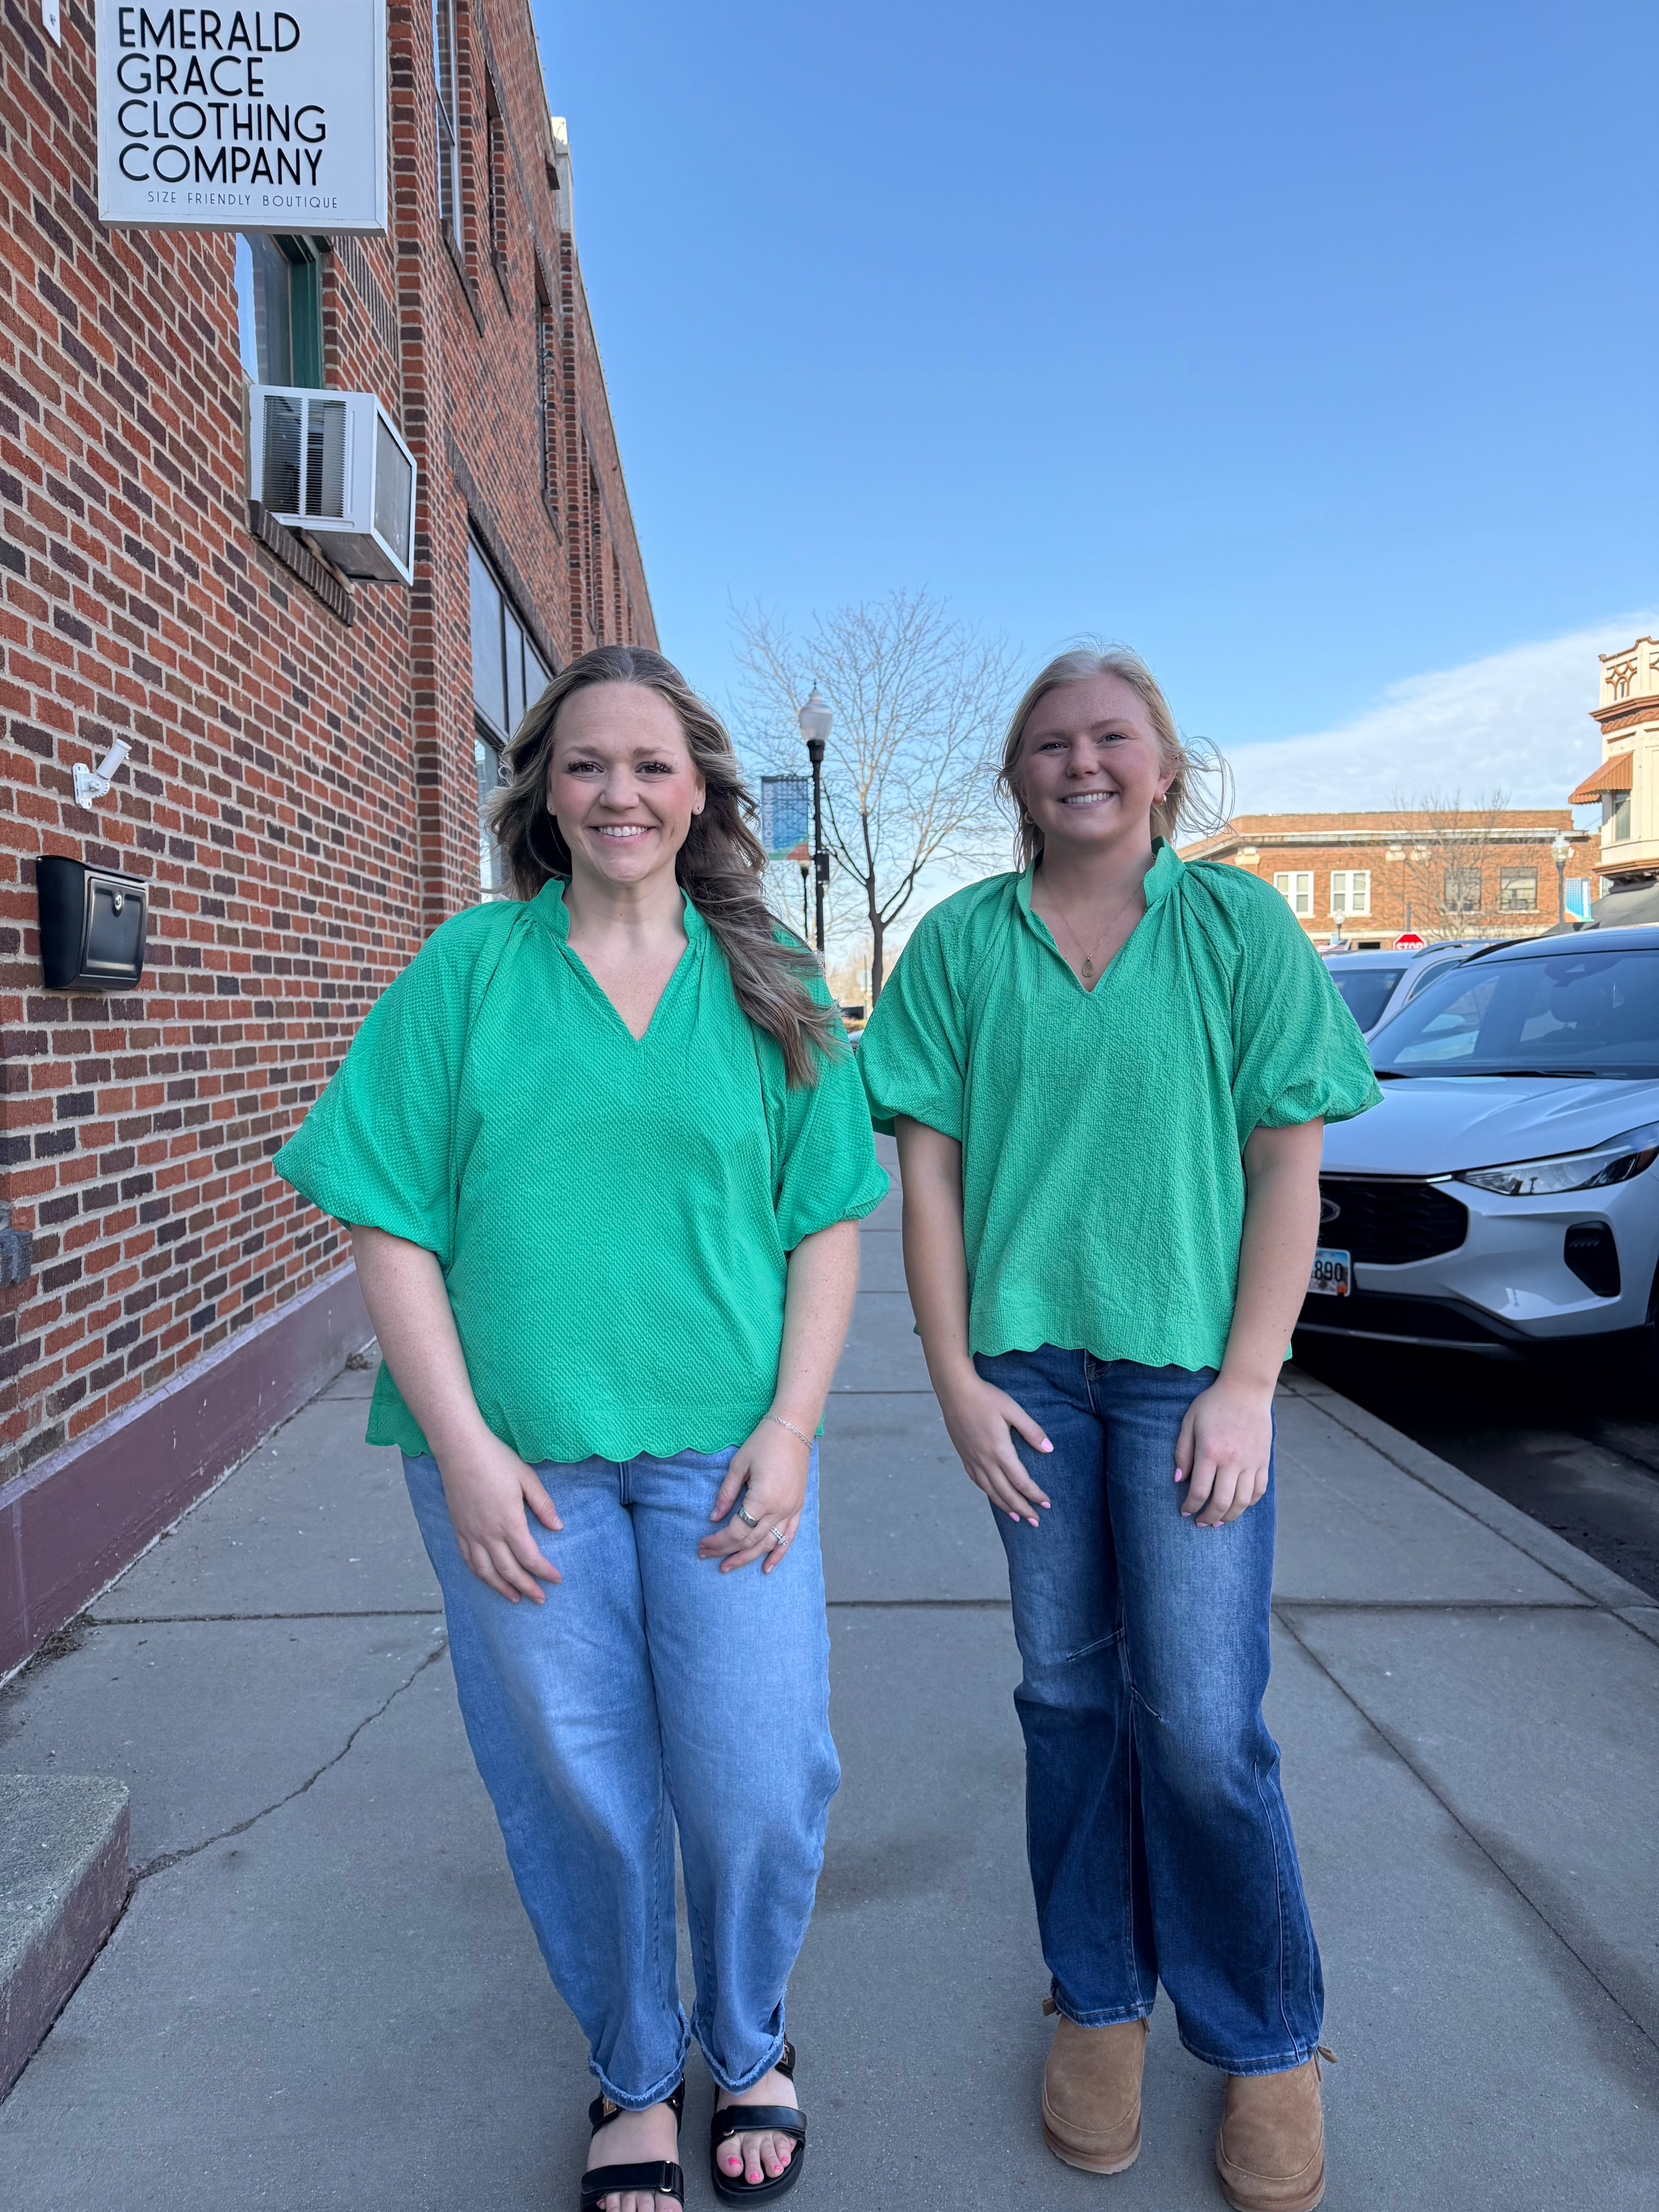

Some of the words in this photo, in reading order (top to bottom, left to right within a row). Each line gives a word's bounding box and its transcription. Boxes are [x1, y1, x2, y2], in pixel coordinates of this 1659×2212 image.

[118, 6, 300, 53] EMERALD
[116, 52, 264, 98] GRACE
[117, 99, 326, 144] CLOTHING
[118, 142, 323, 186] COMPANY
[148, 191, 176, 203] SIZE
[188, 192, 251, 206] FRIENDLY
[263, 195, 338, 209] BOUTIQUE
